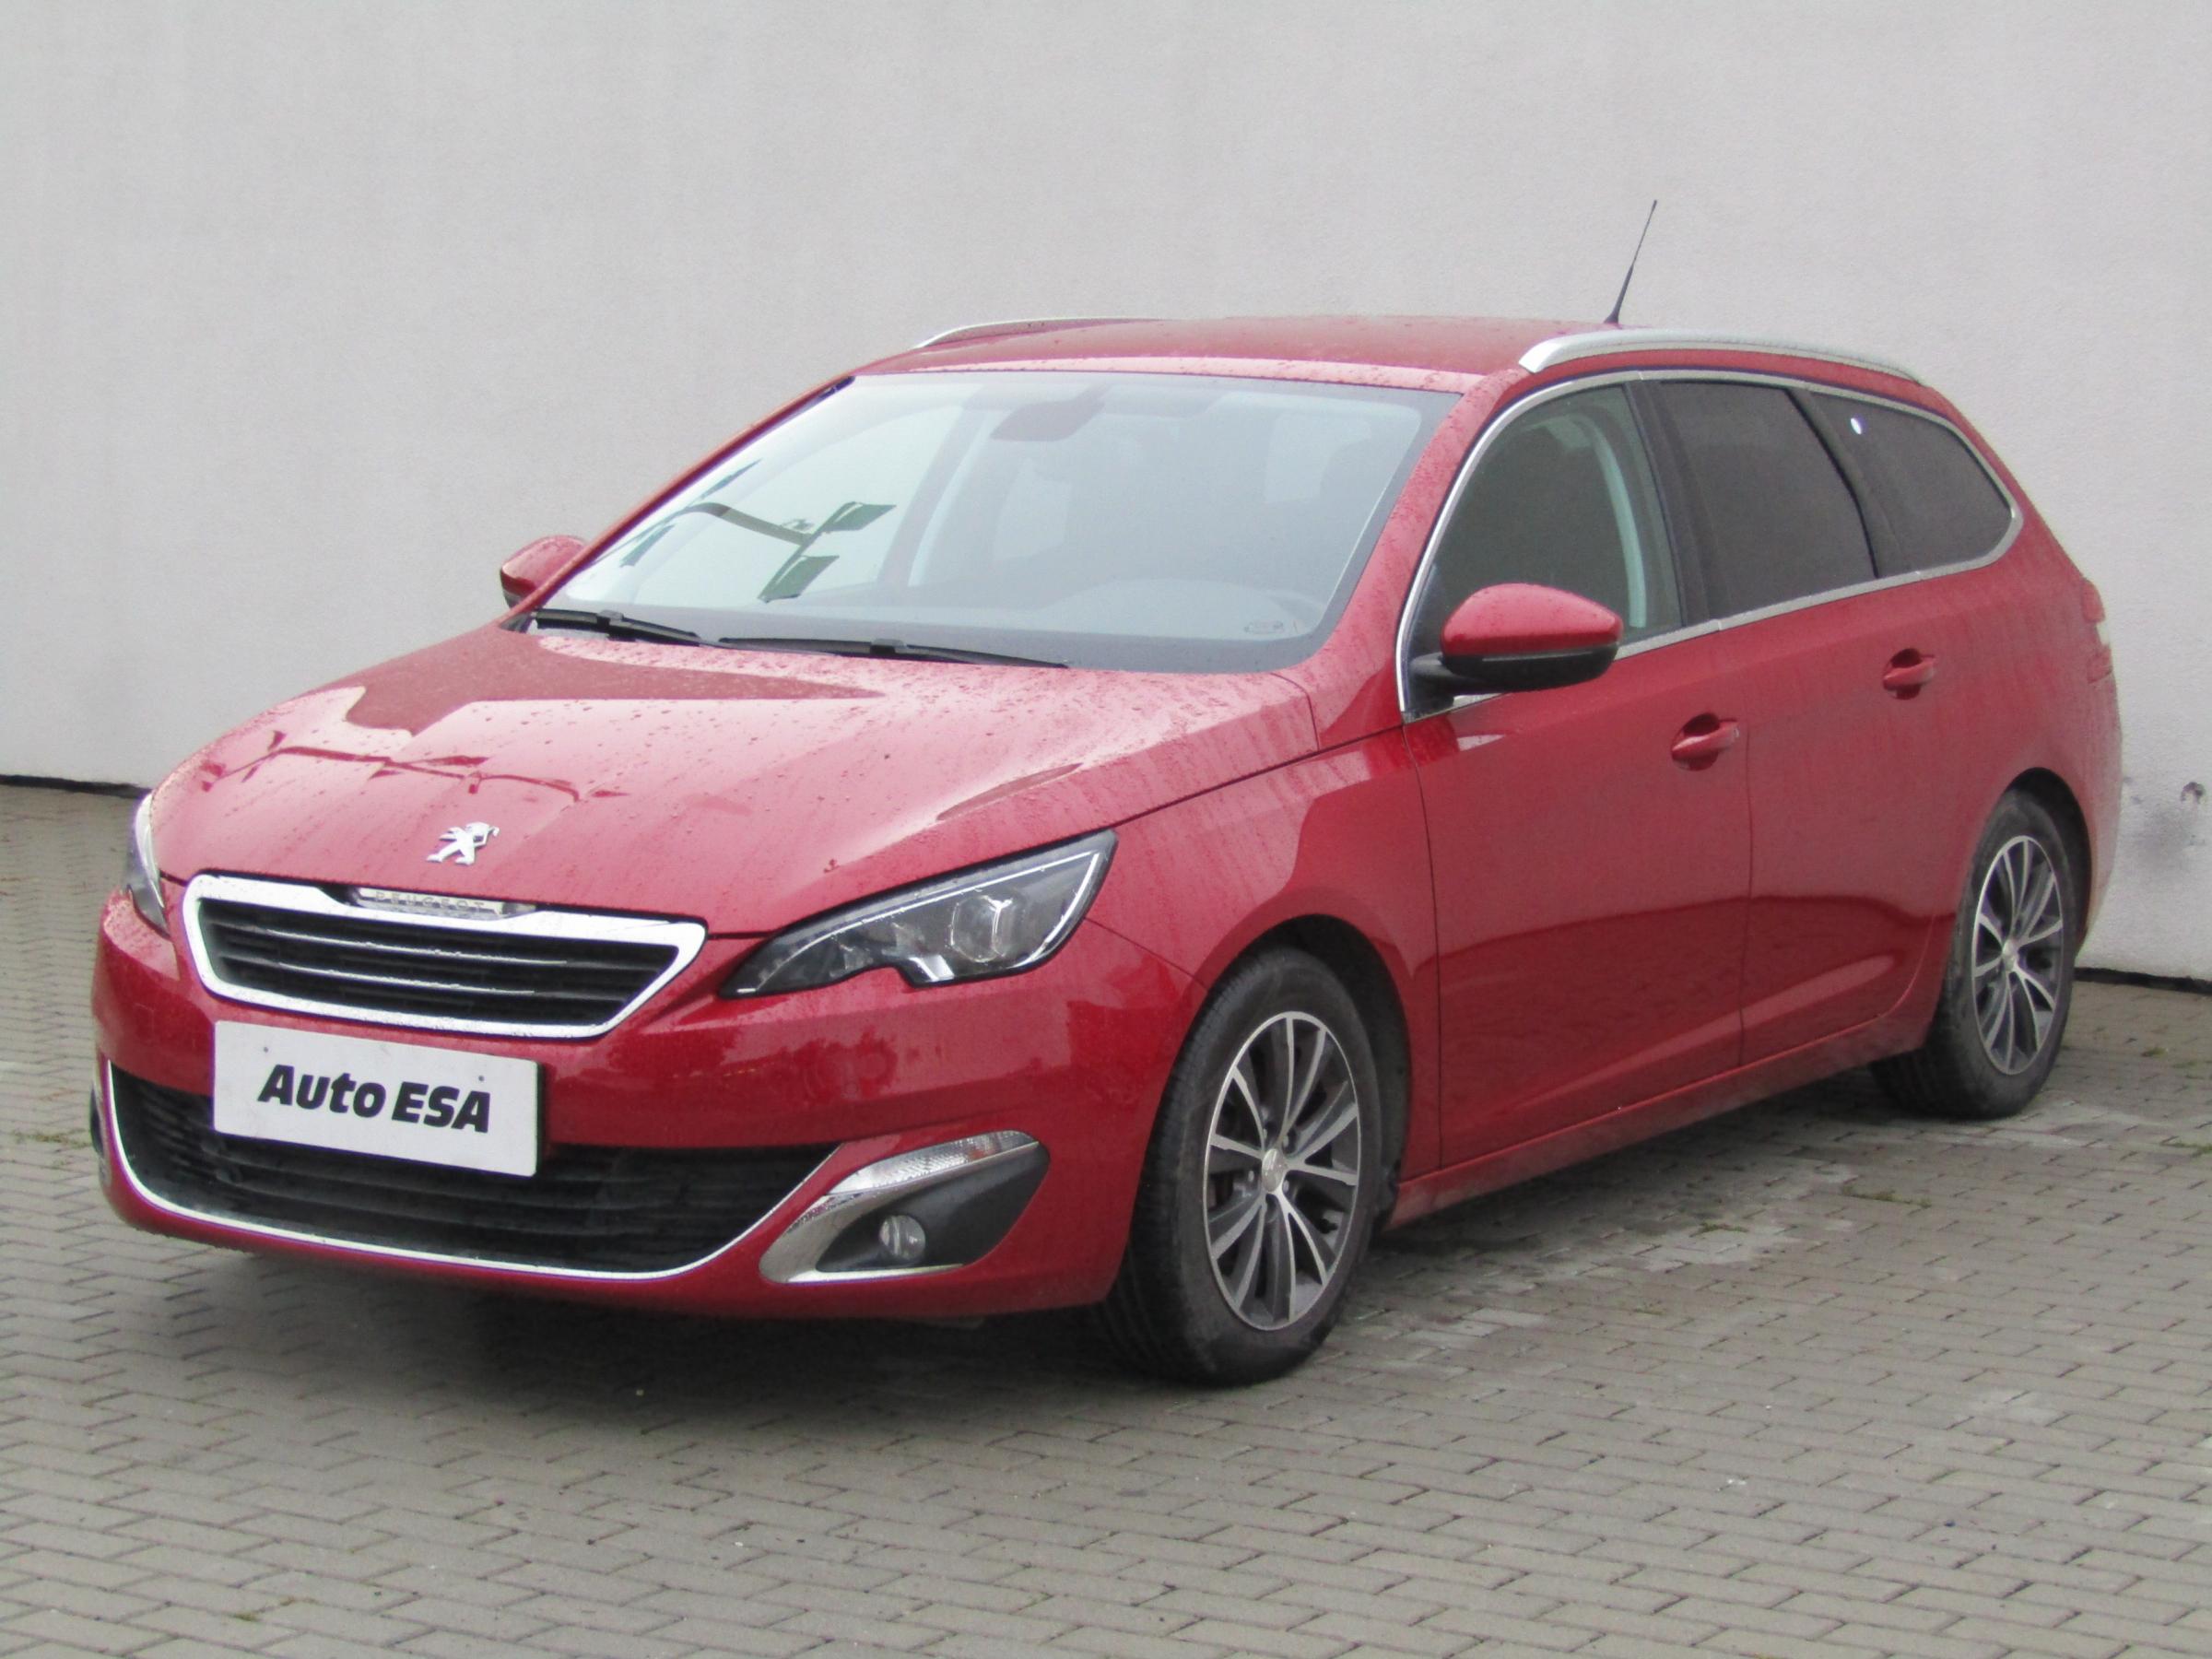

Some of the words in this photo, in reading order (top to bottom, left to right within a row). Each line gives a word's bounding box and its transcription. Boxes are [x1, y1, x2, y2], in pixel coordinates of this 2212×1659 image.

[374, 890, 485, 912] PEUGEOT
[257, 1064, 386, 1118] Auto
[391, 1081, 491, 1134] ESA
